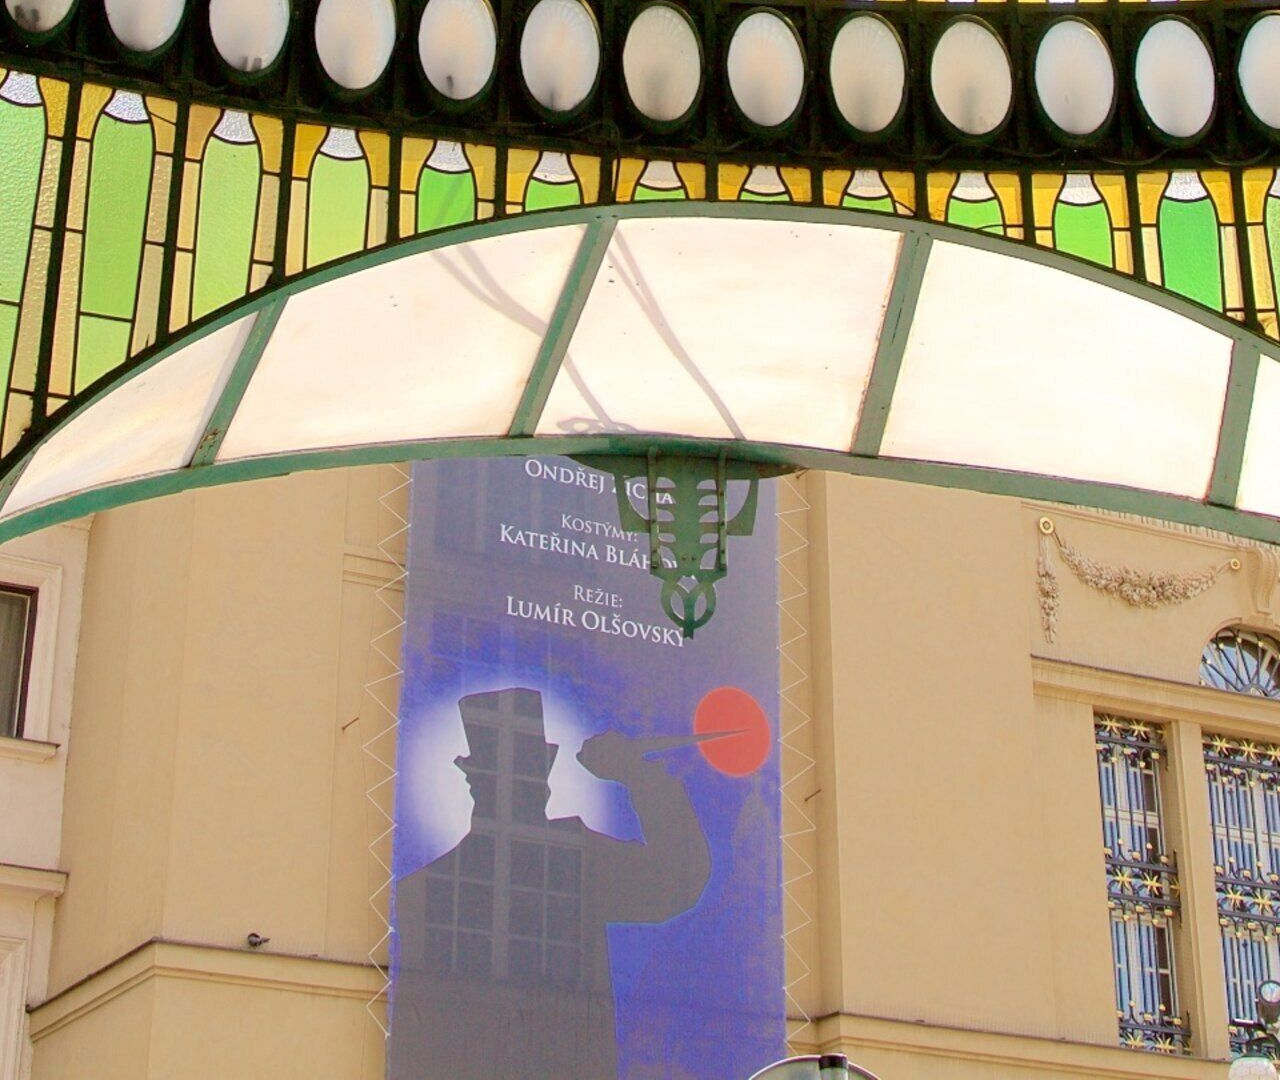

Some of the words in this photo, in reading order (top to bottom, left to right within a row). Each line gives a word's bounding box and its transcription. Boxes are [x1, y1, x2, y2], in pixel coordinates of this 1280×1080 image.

[525, 458, 605, 495] ONDŘEJ
[500, 523, 600, 561] KATEŘINA
[561, 513, 639, 543] KOSTÝMY:
[574, 584, 624, 609] REŽIE:
[506, 595, 577, 628] LUMÍR
[581, 610, 685, 648] OLŠOVSKÝ
